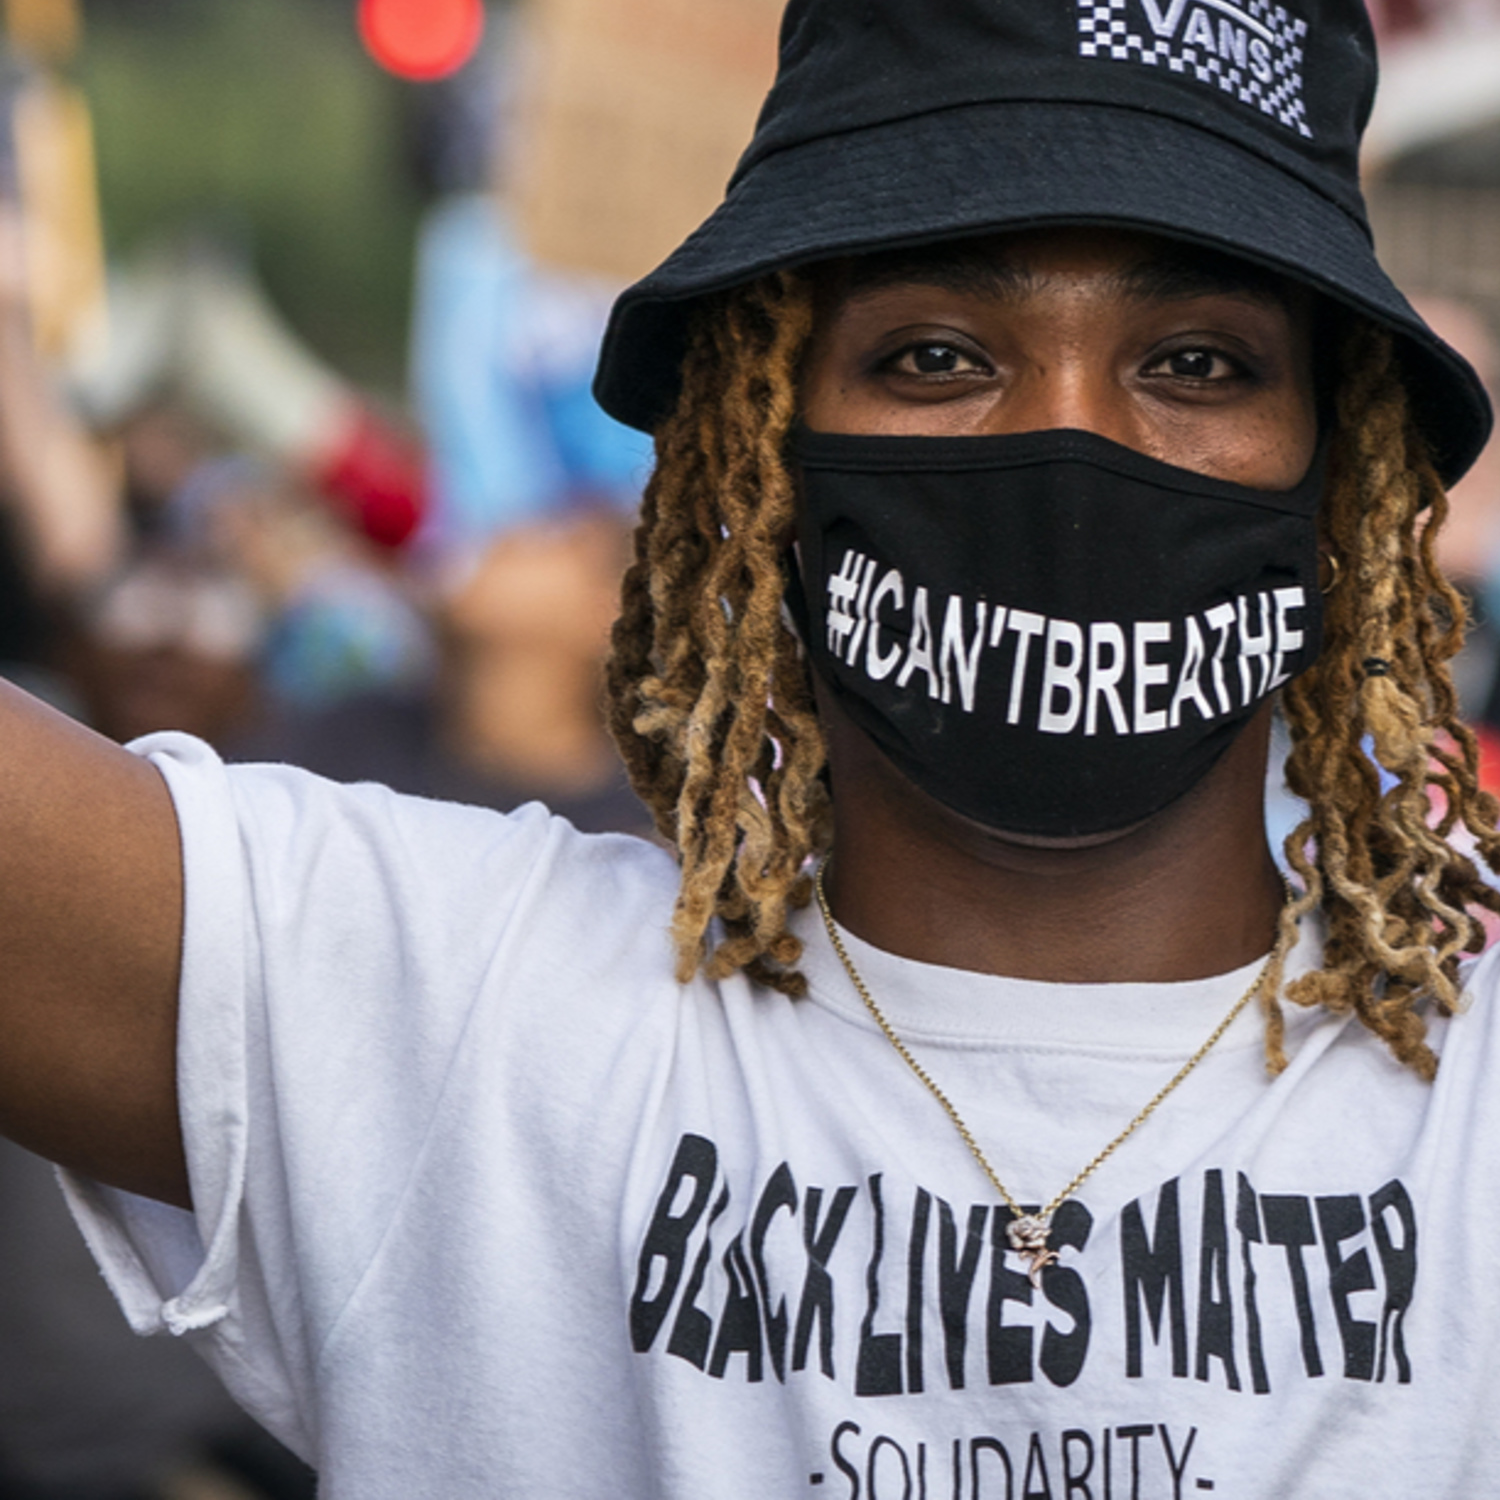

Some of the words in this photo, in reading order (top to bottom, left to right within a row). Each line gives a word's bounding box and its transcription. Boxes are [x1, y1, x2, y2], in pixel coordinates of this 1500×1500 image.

[826, 549, 1306, 736] #ICAN'TBREATHE
[629, 1132, 858, 1384] BLACK
[854, 1171, 1095, 1398] LIVES
[1120, 1167, 1418, 1395] MATTER
